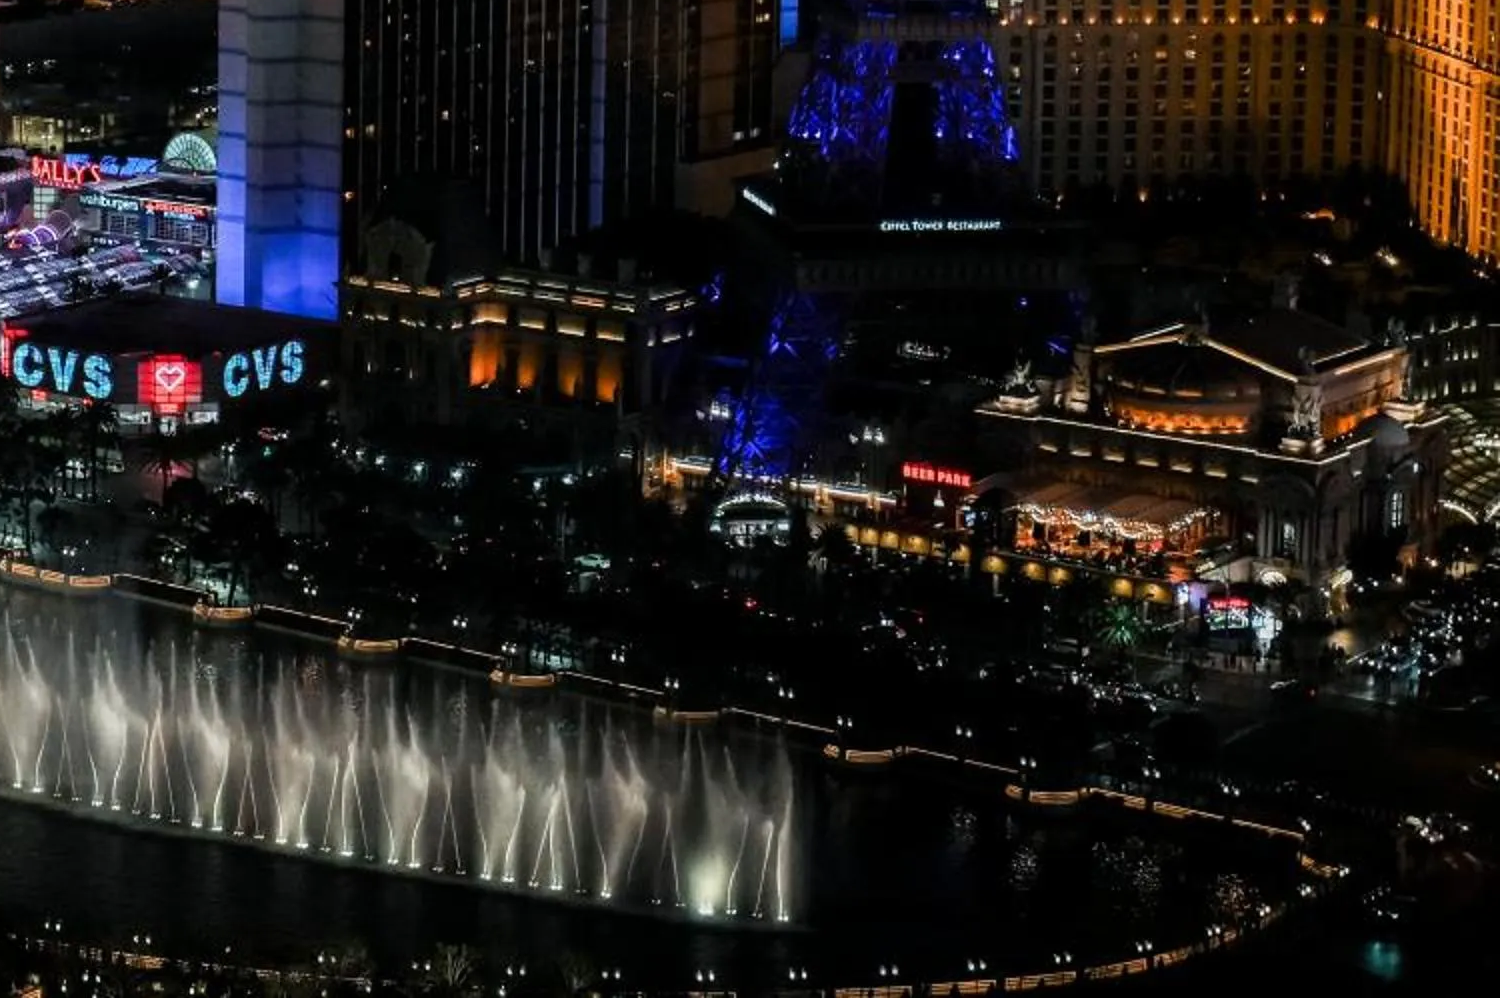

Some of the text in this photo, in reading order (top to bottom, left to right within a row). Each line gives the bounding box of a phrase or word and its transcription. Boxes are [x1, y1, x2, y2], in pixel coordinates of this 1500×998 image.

[13, 343, 114, 398] CVS
[222, 340, 302, 398] CVS
[903, 465, 971, 487] BEER PARK
